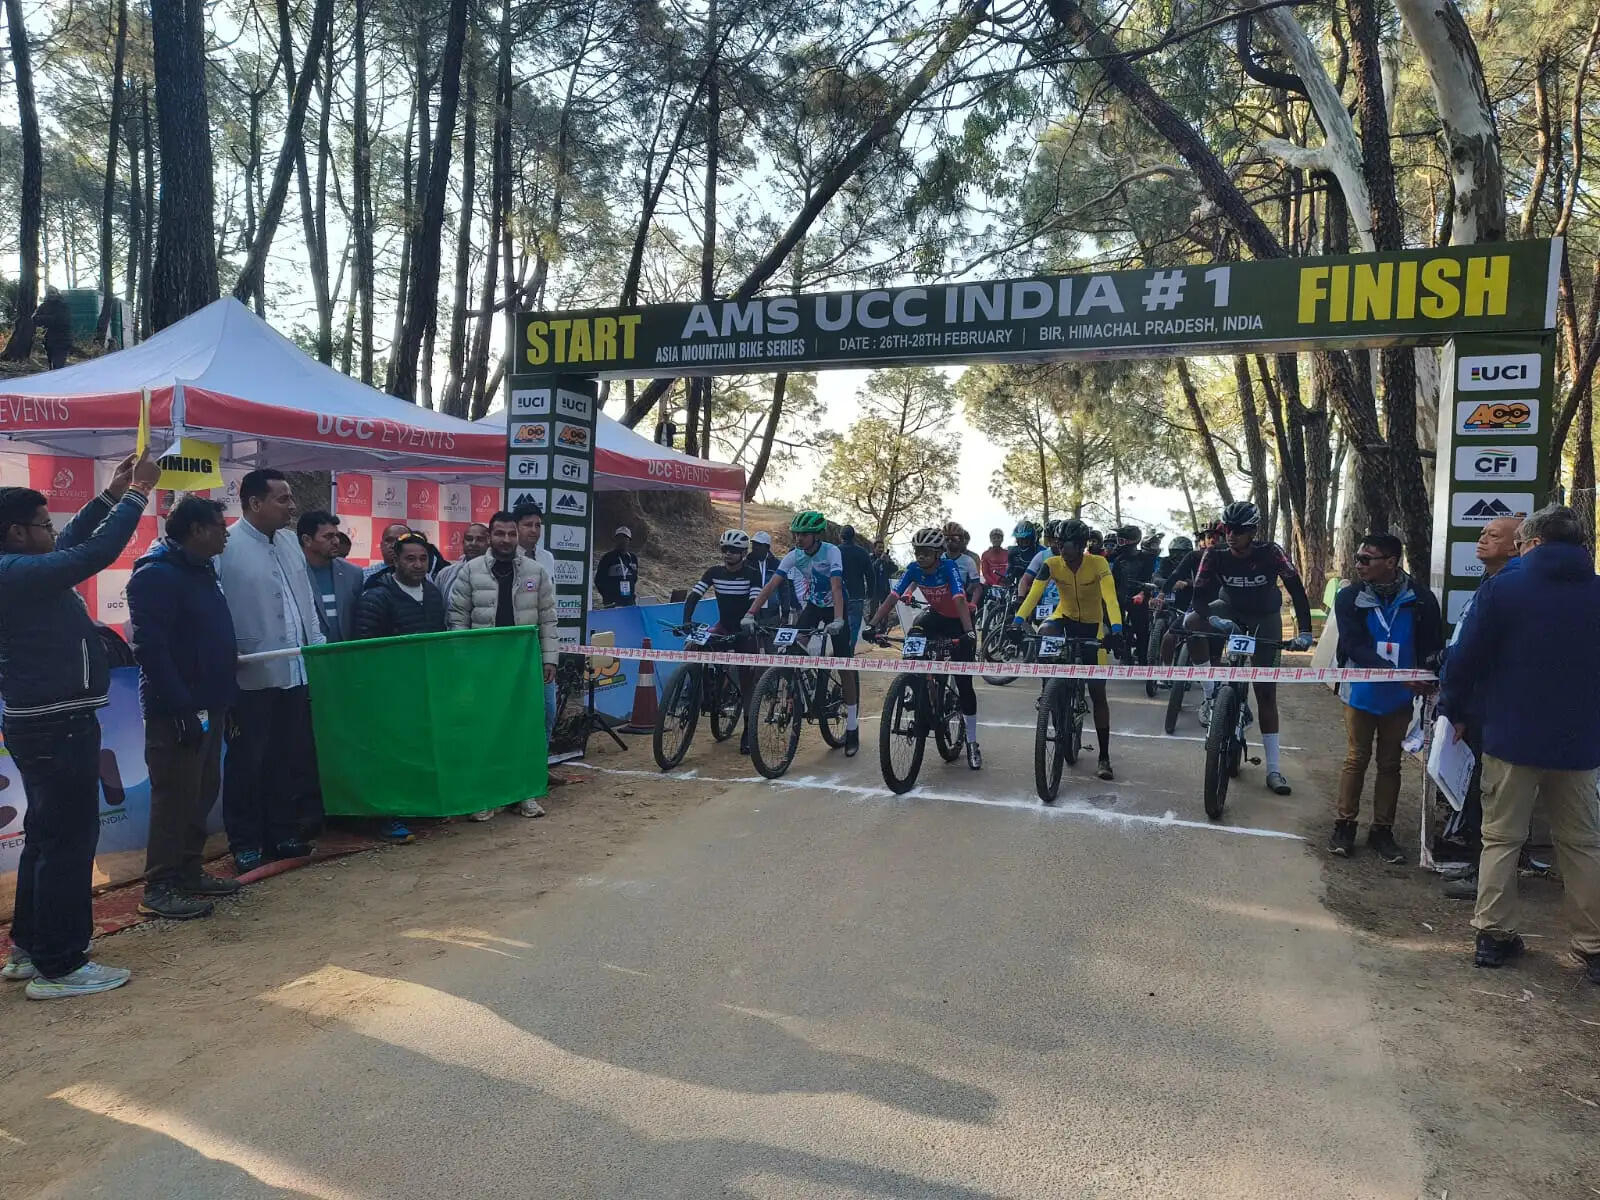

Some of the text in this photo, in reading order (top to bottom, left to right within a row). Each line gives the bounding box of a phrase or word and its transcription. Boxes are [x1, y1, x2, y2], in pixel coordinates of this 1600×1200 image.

[1298, 255, 1510, 324] FINISH
[681, 266, 1232, 339] AMS UCC INDIA # 1
[1040, 314, 1263, 342] BIR, HIMACHAL PRADESH, INDIA
[526, 315, 641, 366] START
[839, 337, 870, 351] DATE
[879, 332, 941, 349] 26TH-28TH
[944, 329, 1013, 346] FEBRUARY
[655, 338, 806, 363] ASIA MOUNTAIN BIKE SERIES
[1481, 365, 1527, 381] UCI
[0, 397, 69, 422] EVENTS
[522, 397, 544, 408] UCI
[566, 398, 587, 413] UCI
[316, 413, 455, 450] UCC EVENTS
[518, 463, 539, 475] CFI
[562, 464, 581, 477] CFI
[648, 459, 710, 483] UCC EVENTS
[1475, 457, 1517, 473] CFI
[1222, 574, 1267, 585] VELO
[778, 631, 793, 642] 53
[1233, 639, 1250, 651] 37
[100, 813, 129, 826] NDIA
[2, 838, 25, 849] FED
